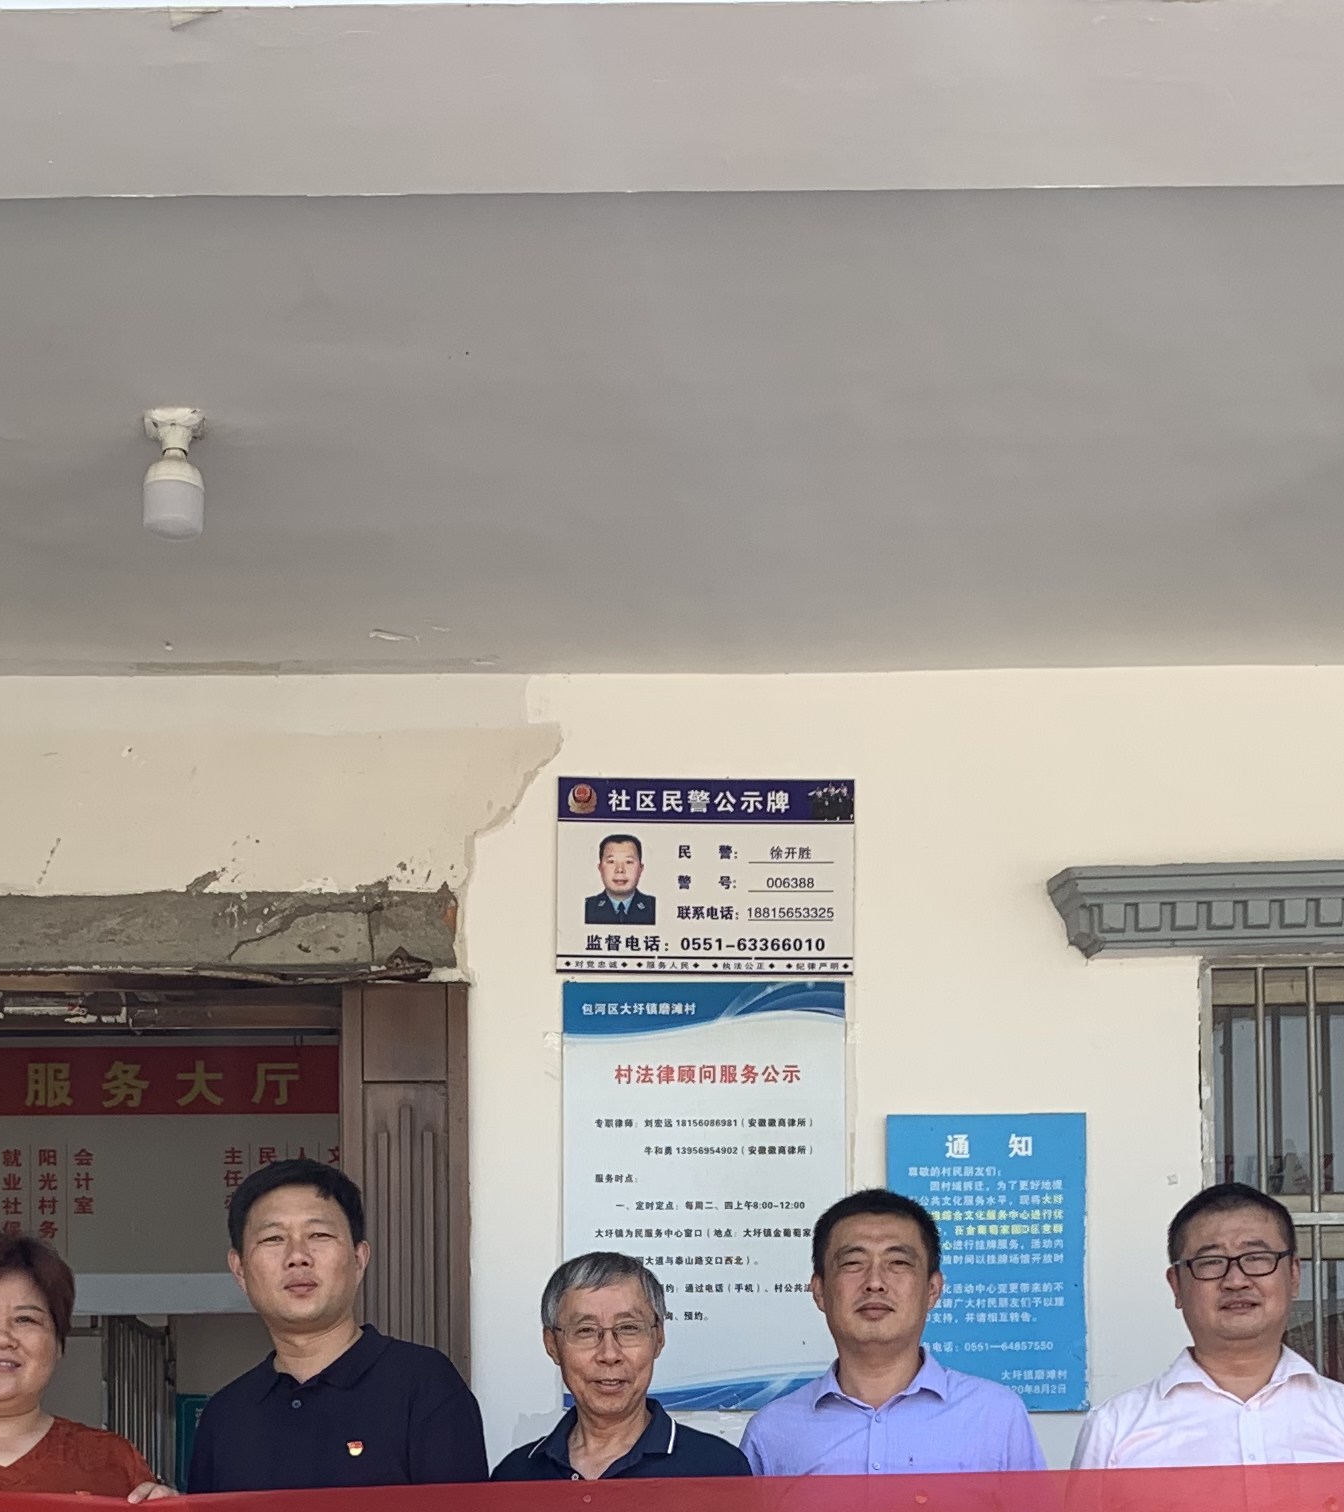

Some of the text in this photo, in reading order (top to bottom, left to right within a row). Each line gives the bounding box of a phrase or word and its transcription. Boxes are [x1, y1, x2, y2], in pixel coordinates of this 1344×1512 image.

[607, 789, 790, 813] 社区民警公示牌
[769, 845, 812, 861] 徐开胜
[766, 877, 815, 890] 006388
[747, 906, 834, 919] 18815653325
[574, 959, 840, 972] 对党忠诚 服务人民 执法公正 纪律严明
[581, 1002, 697, 1016] 包河区大圩镇磨滩村
[614, 1064, 802, 1085] 村法律顾问服务公示
[74, 1148, 94, 1215] 会计室
[38, 1149, 59, 1239] 阳光村务
[661, 1283, 813, 1294] 约：通过电话（手机）、村公共法
